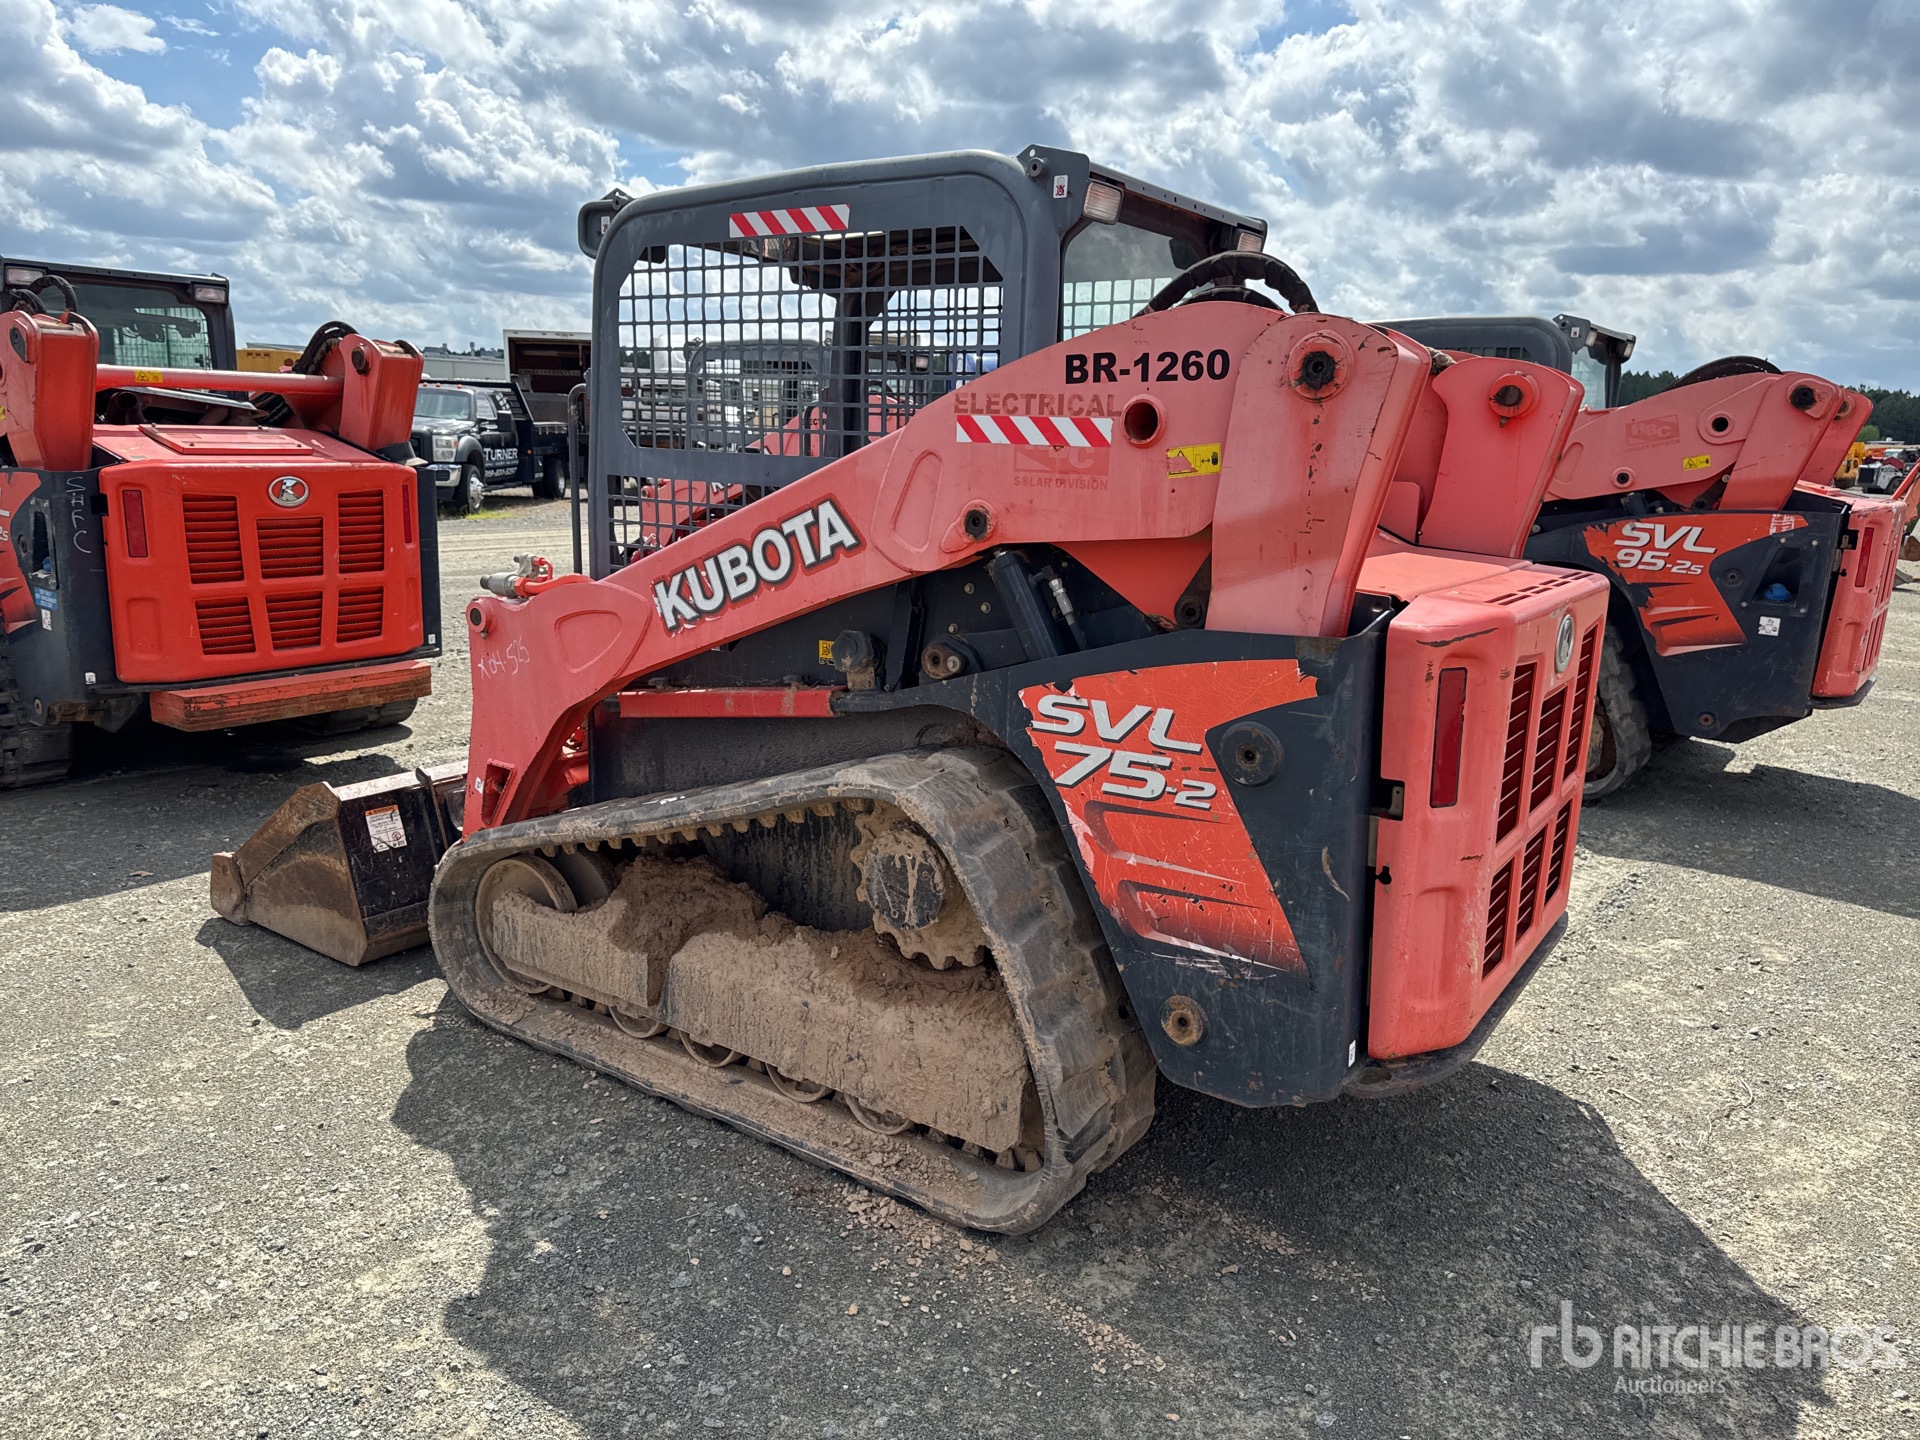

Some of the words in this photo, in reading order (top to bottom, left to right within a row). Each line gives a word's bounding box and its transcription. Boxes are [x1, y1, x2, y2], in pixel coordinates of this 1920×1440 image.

[1065, 348, 1230, 384] BR-1260
[954, 392, 1122, 417] ELECTRICAL
[484, 448, 518, 461] TURNER
[1014, 475, 1051, 488] SOLAR
[1614, 522, 1717, 554] SVL
[654, 500, 860, 631] KUBOTA
[1031, 694, 1203, 755] SVL
[1054, 740, 1217, 811] 75-2
